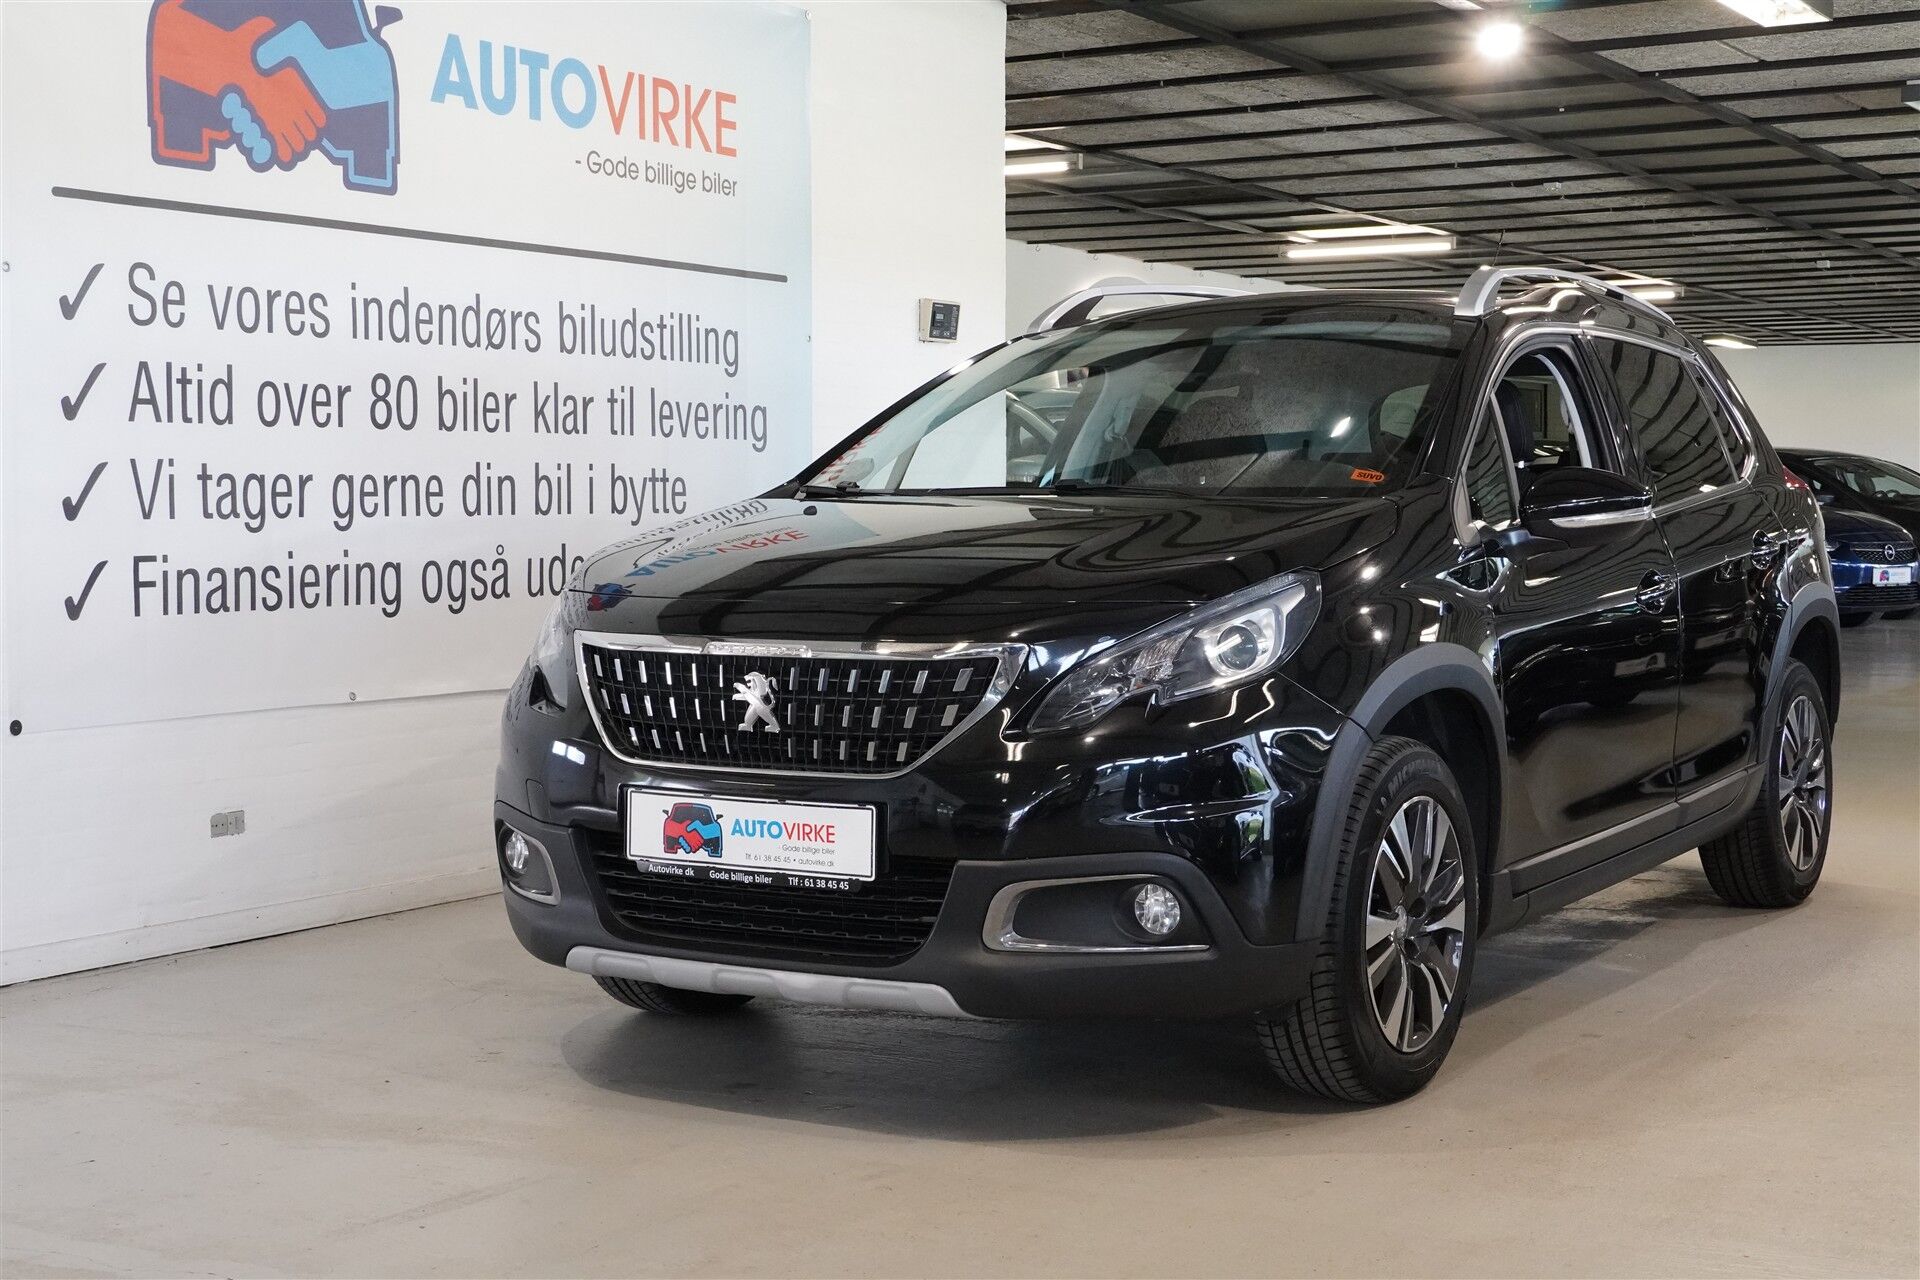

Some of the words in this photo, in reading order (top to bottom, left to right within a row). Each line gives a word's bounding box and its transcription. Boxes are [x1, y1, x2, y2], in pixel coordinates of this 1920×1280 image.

[430, 33, 737, 158] AUTOVIRKE
[587, 150, 639, 181] Gode
[645, 160, 697, 194] billige
[702, 170, 738, 197] biler
[128, 261, 186, 329] Se
[207, 284, 331, 339] vores
[350, 282, 543, 356] indendørs
[558, 300, 740, 379] biludstilling
[128, 360, 234, 425] Altid
[256, 381, 352, 432] over
[370, 373, 419, 432] 80
[437, 375, 518, 434] biler
[533, 381, 595, 437] klar
[607, 385, 636, 437] til
[650, 387, 768, 454] levering
[130, 457, 175, 520] Vi
[196, 462, 314, 534] tager
[332, 473, 444, 534] gerne
[461, 461, 518, 518] din
[534, 461, 572, 517] bil
[588, 462, 595, 516] i
[609, 462, 687, 527] bytte
[132, 548, 402, 622] Finansiering
[422, 543, 512, 617] også
[730, 818, 836, 844] AUTOVIRKE
[781, 844, 801, 853] Gode
[648, 863, 683, 876] Autovirke
[709, 869, 730, 880] Gode
[730, 871, 753, 884] billige
[754, 874, 773, 885] biler
[804, 878, 814, 888] 61
[816, 878, 826, 889] 38
[827, 879, 837, 890] 45
[838, 880, 849, 891] 45
